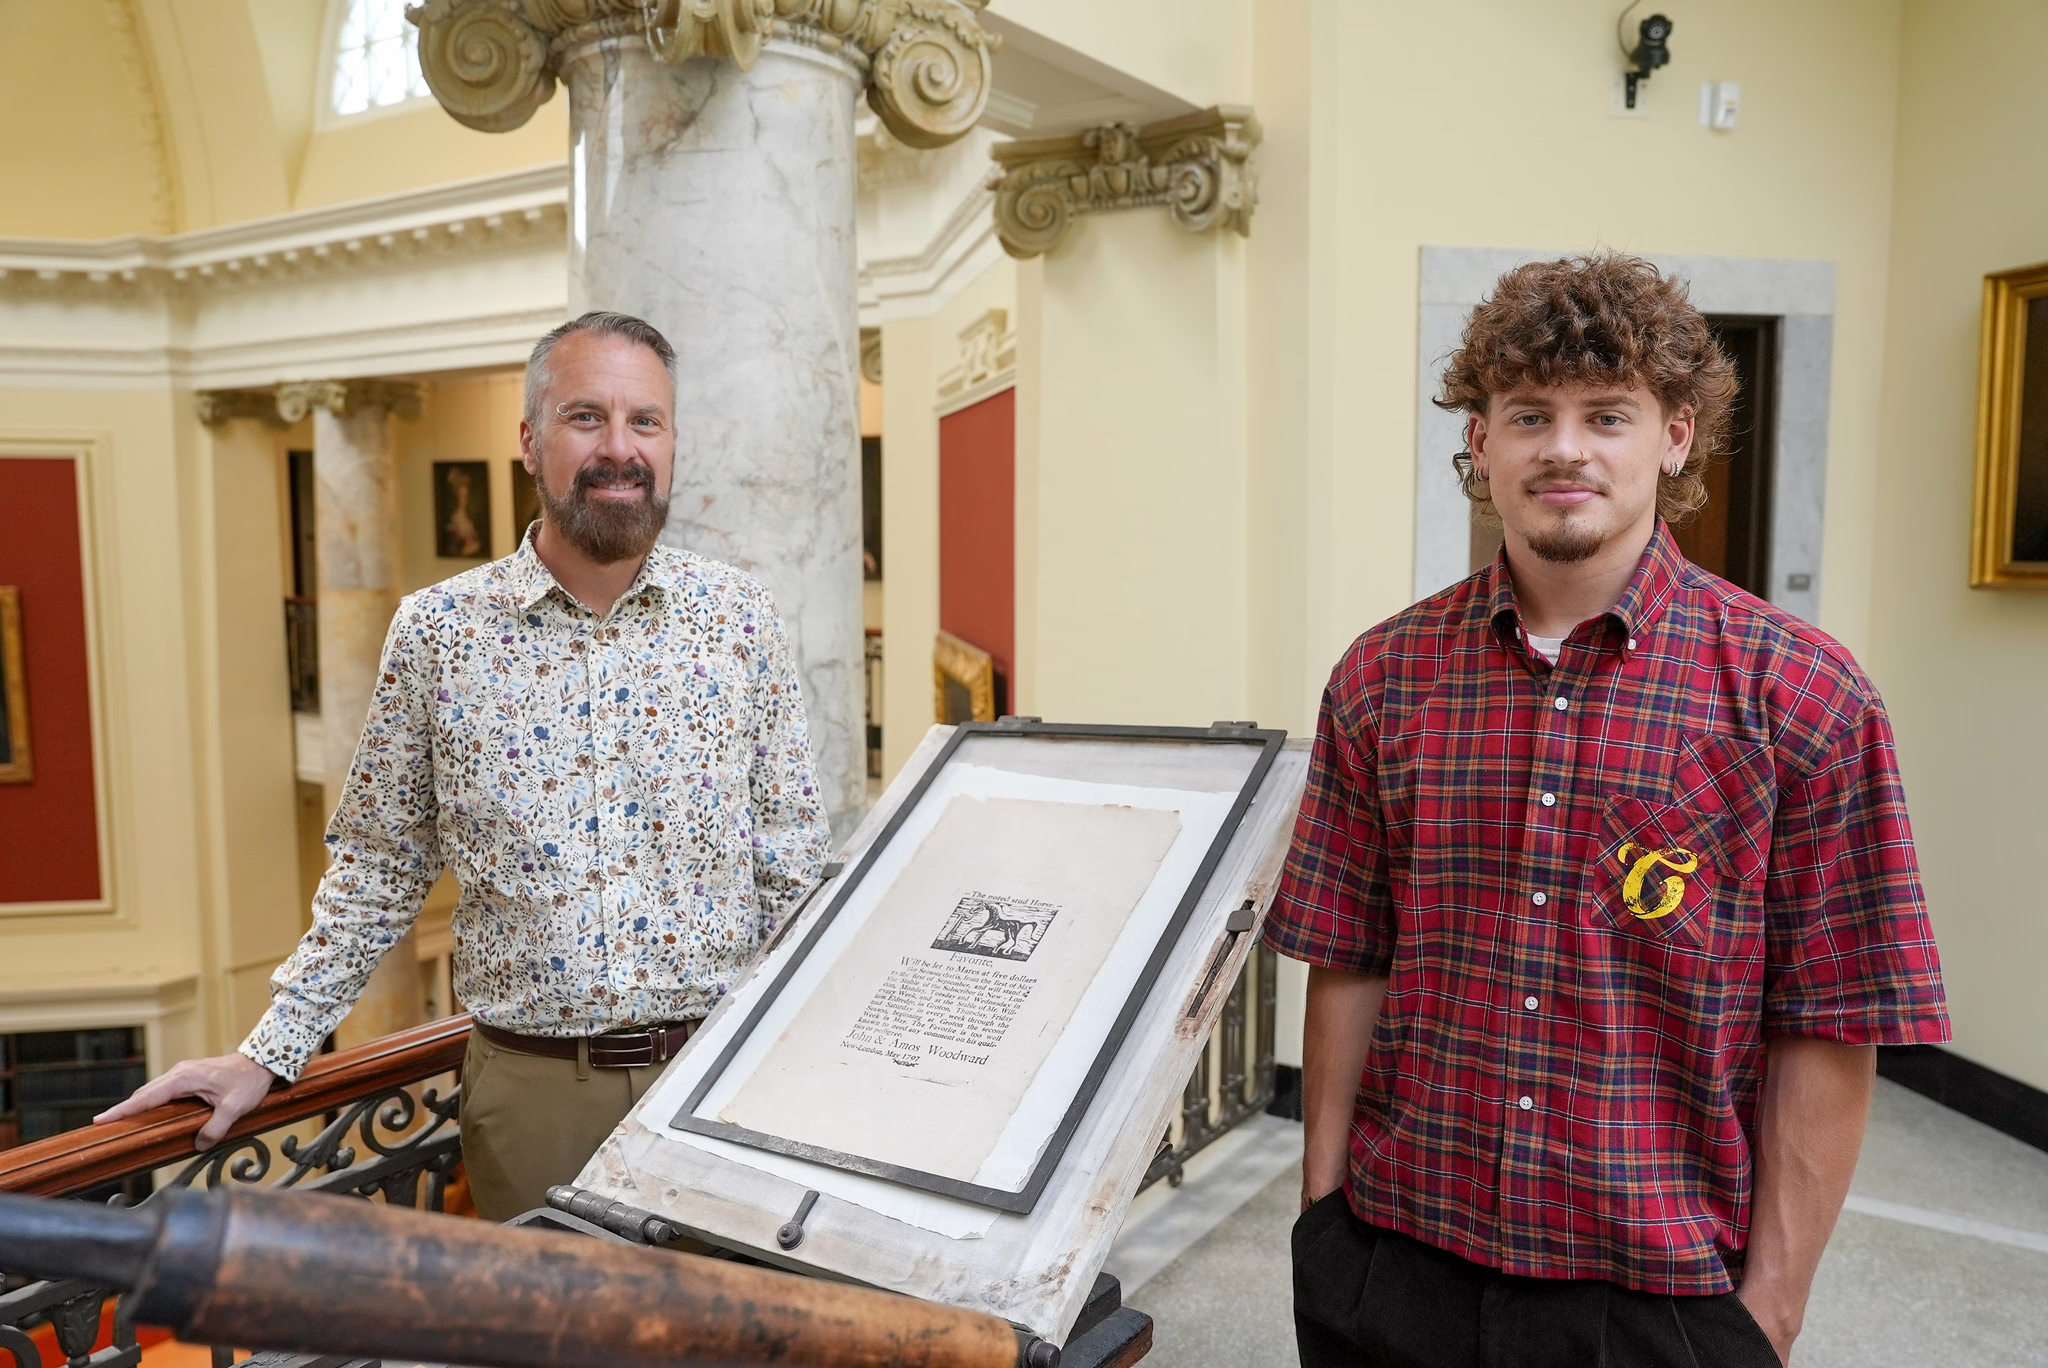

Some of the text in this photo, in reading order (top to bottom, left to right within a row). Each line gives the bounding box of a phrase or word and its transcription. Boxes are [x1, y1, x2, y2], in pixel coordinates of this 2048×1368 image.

[949, 952, 993, 968] Favorite,
[901, 956, 922, 966] Will
[955, 965, 980, 975] Mares
[991, 970, 1008, 979] five
[1009, 974, 1037, 984] dollars
[899, 977, 920, 986] Stable
[942, 984, 976, 995] Subscriber
[962, 974, 980, 982] from
[1017, 983, 1033, 992] May
[930, 989, 956, 999] Tuesday
[974, 996, 1011, 1008] Wednesday
[956, 1001, 977, 1009] Stable
[863, 1010, 880, 1019] Week
[911, 1019, 925, 1028] The
[928, 1023, 957, 1034] Favorite
[885, 1001, 913, 1012] Saturday
[925, 1010, 945, 1018] every
[967, 1017, 994, 1026] through
[892, 1009, 923, 1021] beginning
[939, 1018, 963, 1028] Groton
[981, 1025, 1006, 1035] second
[991, 1013, 1013, 1023] Friday
[857, 1016, 880, 1026] known
[923, 1031, 955, 1041] comment
[846, 1029, 989, 1065] John & Amos Woodward
[884, 1050, 901, 1059] May
